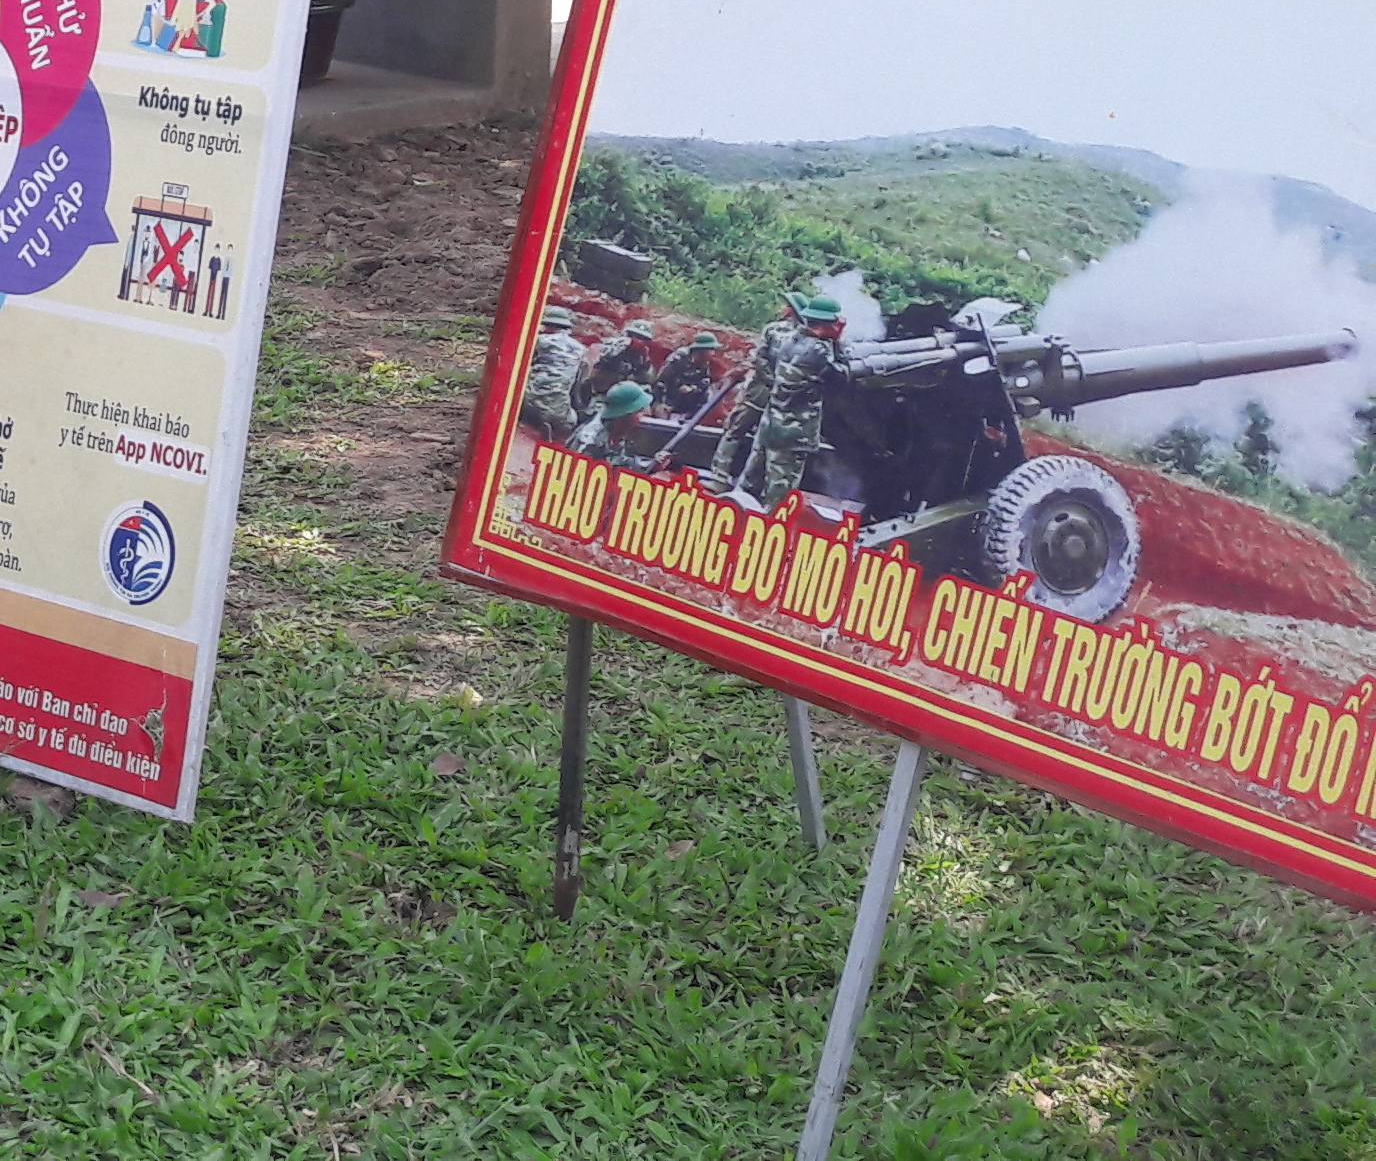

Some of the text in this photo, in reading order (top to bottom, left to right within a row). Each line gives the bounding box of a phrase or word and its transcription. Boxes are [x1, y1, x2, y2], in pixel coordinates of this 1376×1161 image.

[139, 86, 242, 126] Không tụ tập
[18, 181, 85, 268] TỤ TẬP
[66, 392, 189, 438] Thực hiện khai báo
[59, 426, 206, 476] y tế trên App NCOVI.
[528, 446, 608, 539] THAO
[608, 472, 734, 584] TRƯỜNG
[732, 493, 799, 601] ĐỔ
[784, 516, 855, 623] MỒ
[844, 544, 917, 660] HÔI,
[923, 576, 1044, 693] CHIẾN
[1042, 622, 1202, 750] TRƯỜNG
[1200, 666, 1294, 780] BỚT
[1287, 684, 1372, 805] ĐỔ
[18, 686, 39, 708] với
[42, 691, 69, 718] Ban
[74, 703, 97, 726] chỉ
[101, 710, 127, 737] đạo
